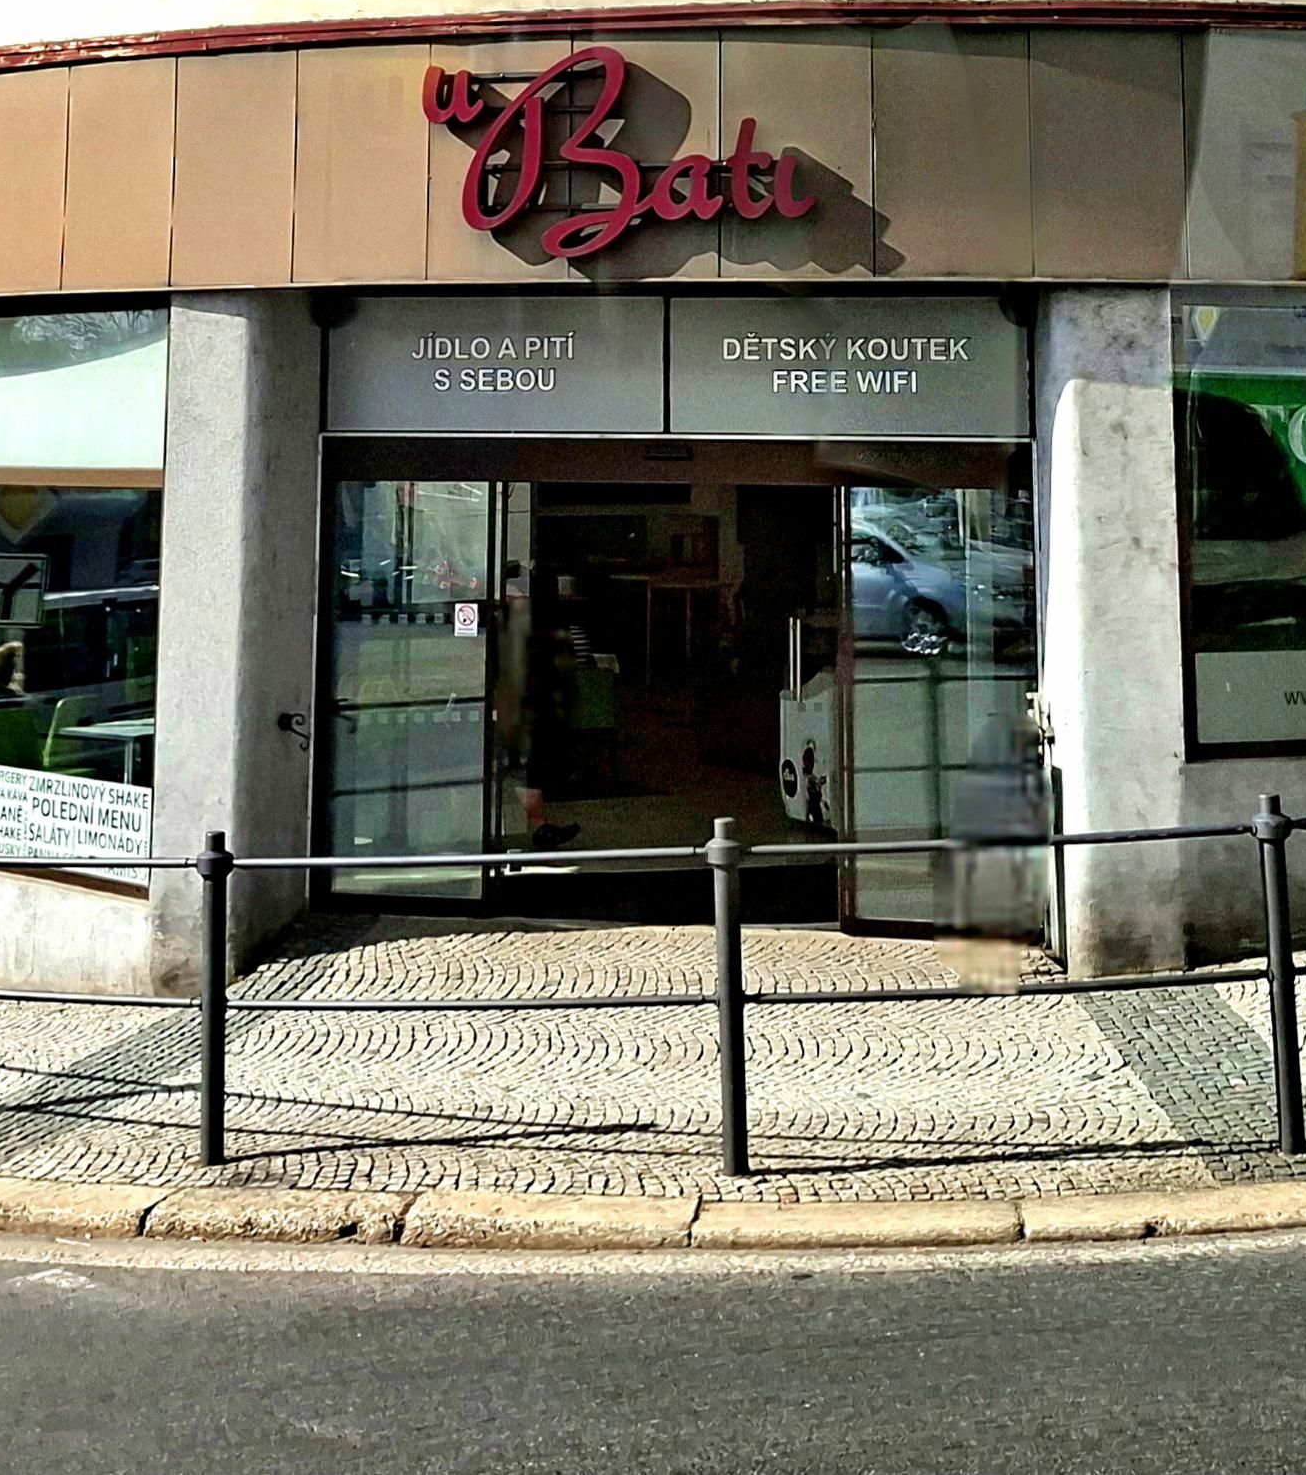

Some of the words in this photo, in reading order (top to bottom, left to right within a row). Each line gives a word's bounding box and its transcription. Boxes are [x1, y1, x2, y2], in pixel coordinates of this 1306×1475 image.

[422, 66, 484, 123] u
[462, 46, 816, 257] Bati
[412, 332, 492, 361] JÍDLO
[498, 338, 517, 360] A
[524, 331, 574, 360] PITÍ
[722, 332, 838, 362] DĚTSKÝ
[846, 337, 971, 362] KOUTEK
[434, 369, 451, 393] S
[459, 369, 556, 393] SEBOU
[773, 370, 848, 395] FREE
[856, 370, 919, 395] WIFI
[108, 788, 149, 810] SHAKE
[32, 796, 94, 825] POLEDNÍ
[97, 807, 142, 833] MENU
